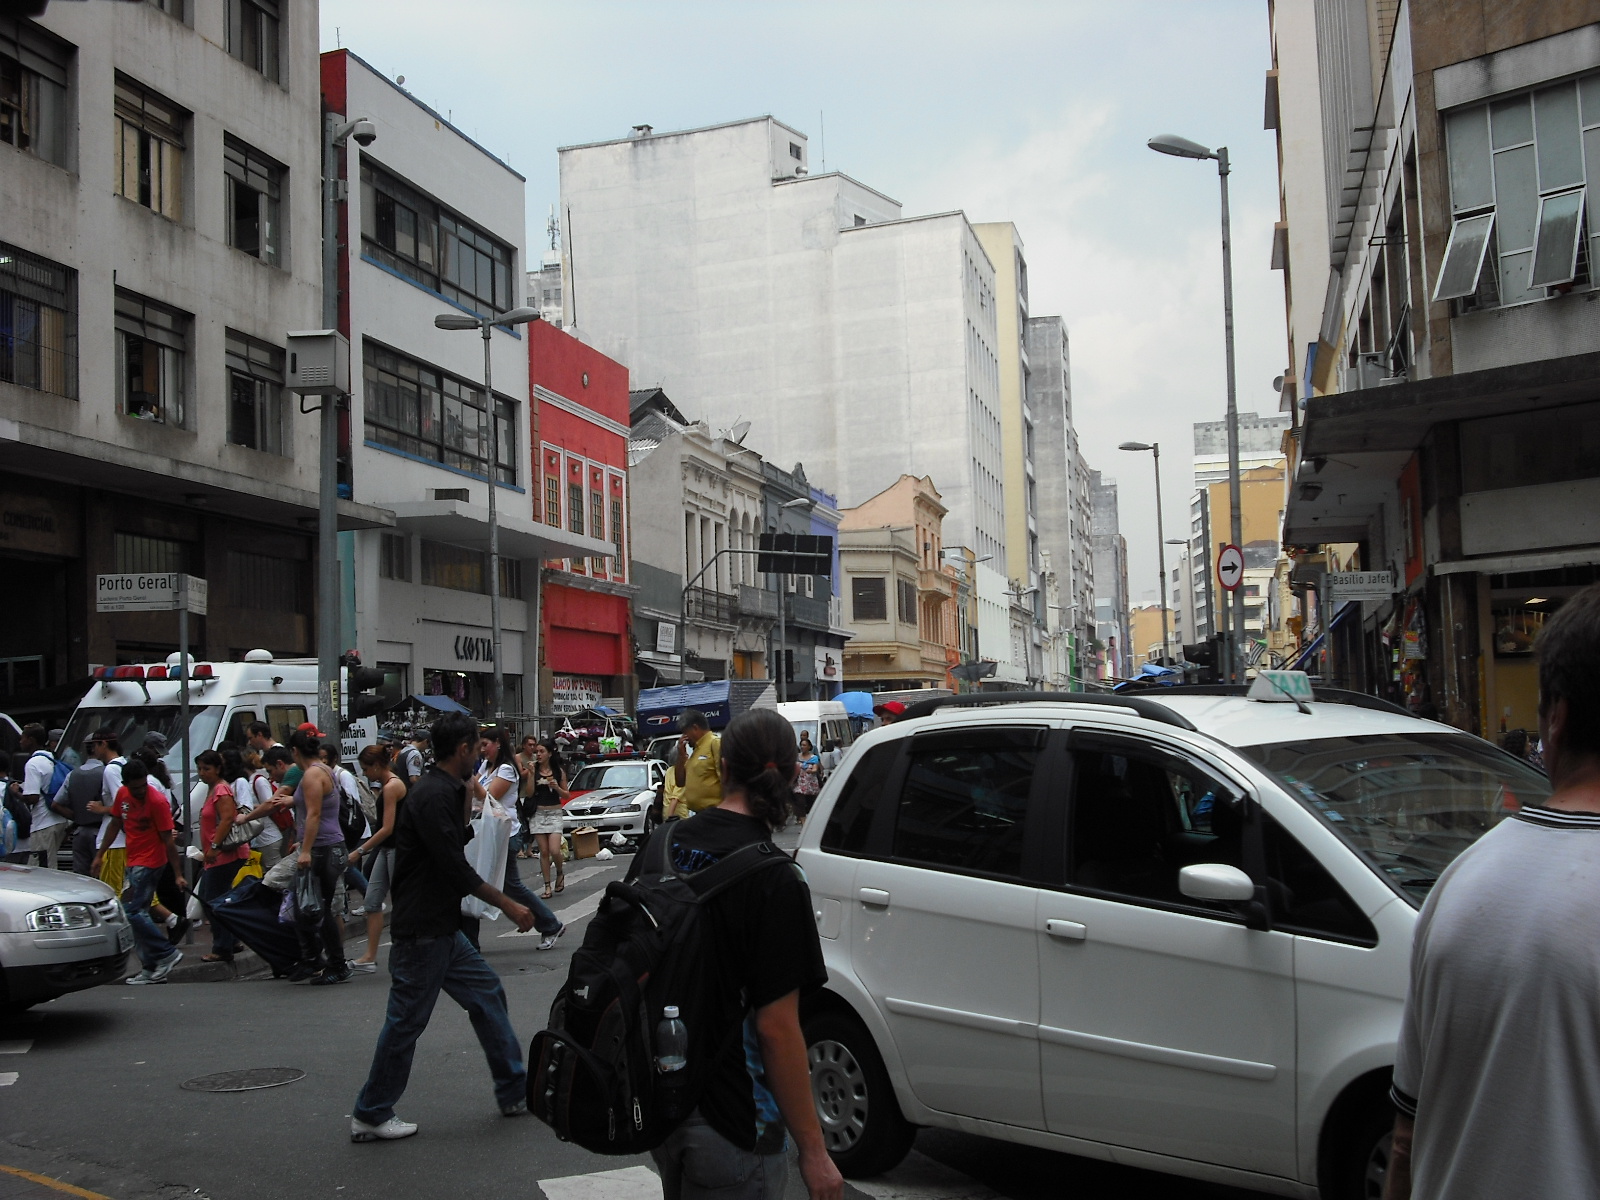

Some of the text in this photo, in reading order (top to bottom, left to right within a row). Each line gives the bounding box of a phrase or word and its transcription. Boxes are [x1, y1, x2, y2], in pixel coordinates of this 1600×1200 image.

[99, 577, 133, 591] Porto
[138, 574, 172, 590] Geral
[1367, 573, 1390, 584] Jafet
[1267, 673, 1311, 695] TAXI
[671, 710, 720, 722] TRGNA
